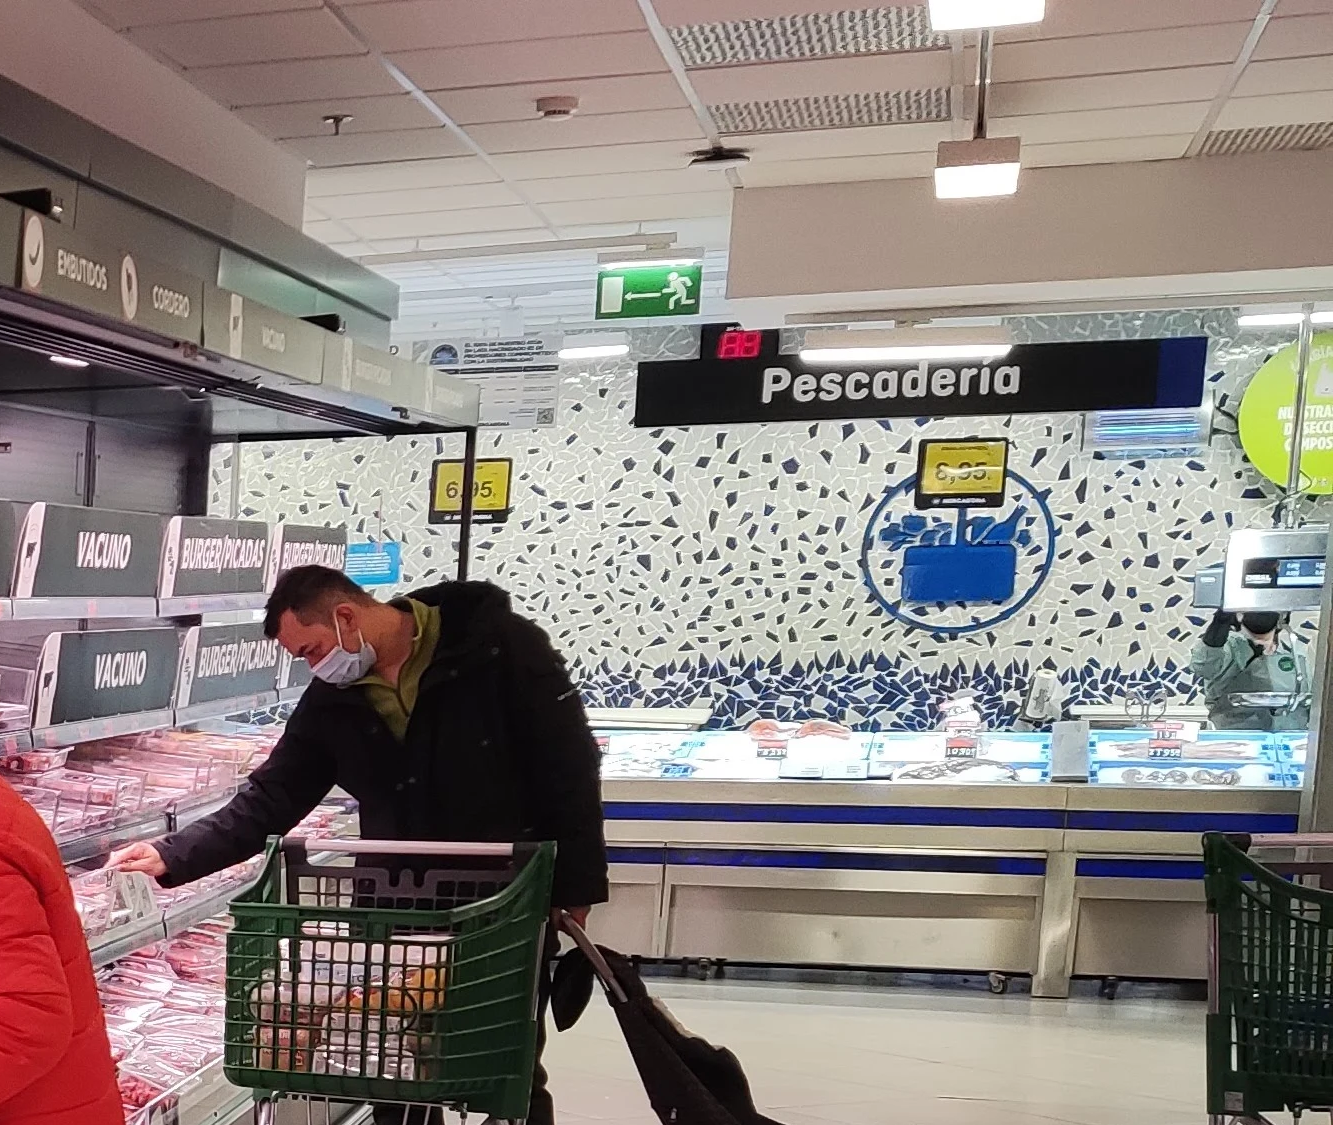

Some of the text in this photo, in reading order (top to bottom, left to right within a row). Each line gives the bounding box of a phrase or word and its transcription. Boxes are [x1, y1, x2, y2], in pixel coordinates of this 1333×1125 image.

[57, 248, 108, 291] EMBUTIDOS
[152, 284, 190, 318] CORDERO
[761, 357, 1021, 404] Pescadería
[1278, 404, 1333, 421] NUSTRA
[1284, 436, 1333, 451] CMPOS
[77, 531, 131, 569] VACUNO
[180, 535, 266, 574] BURGER/PICADAS
[94, 650, 147, 690] VACUNO
[197, 637, 278, 679] BURGER/PICADAS
